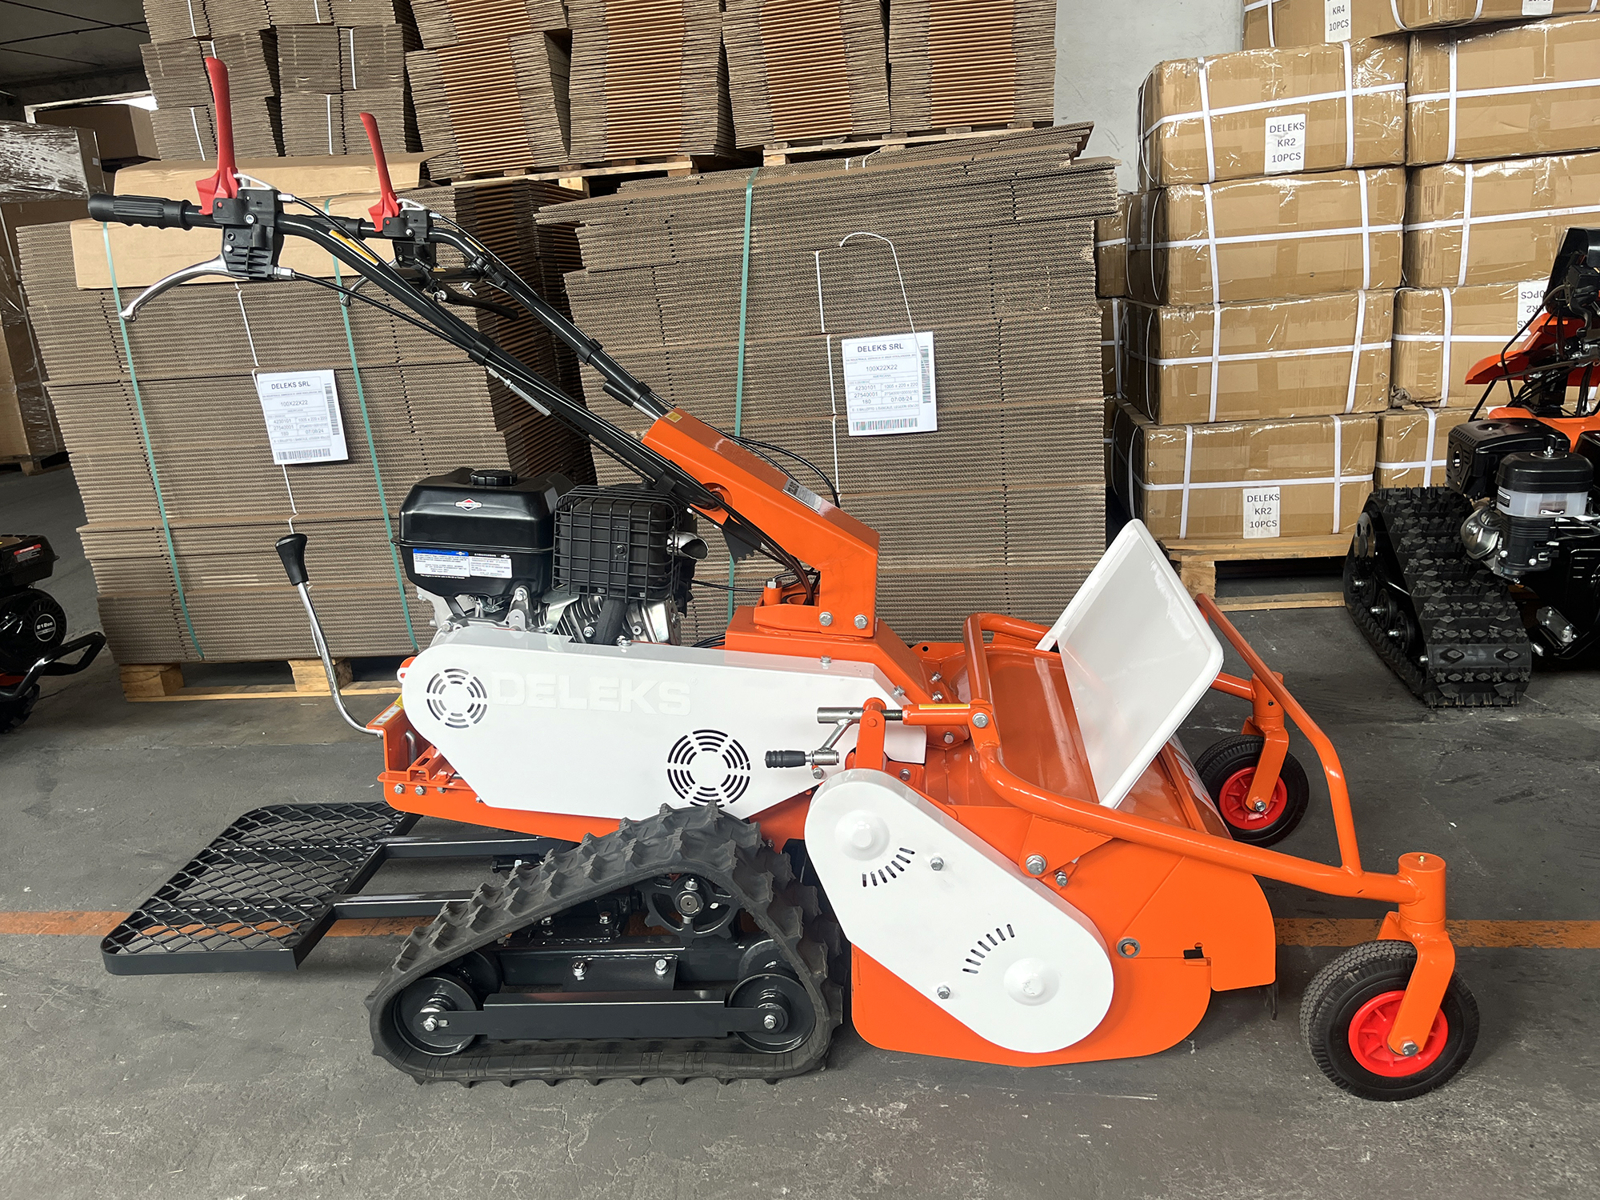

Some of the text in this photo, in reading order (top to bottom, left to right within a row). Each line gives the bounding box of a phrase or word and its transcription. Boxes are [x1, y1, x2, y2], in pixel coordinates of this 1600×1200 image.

[1333, 5, 1345, 15] KR4
[1329, 19, 1349, 31] 10PCS
[1270, 122, 1305, 133] DELEKS
[1278, 138, 1296, 147] KR2
[1272, 152, 1301, 163] 10PCS
[1521, 290, 1545, 300] 0PCS
[857, 344, 887, 353] DELEKS
[271, 382, 297, 390] DELEKS
[1247, 494, 1280, 502] DELEKS
[1250, 520, 1277, 528] 10PCS
[491, 671, 691, 716] DELEKS
